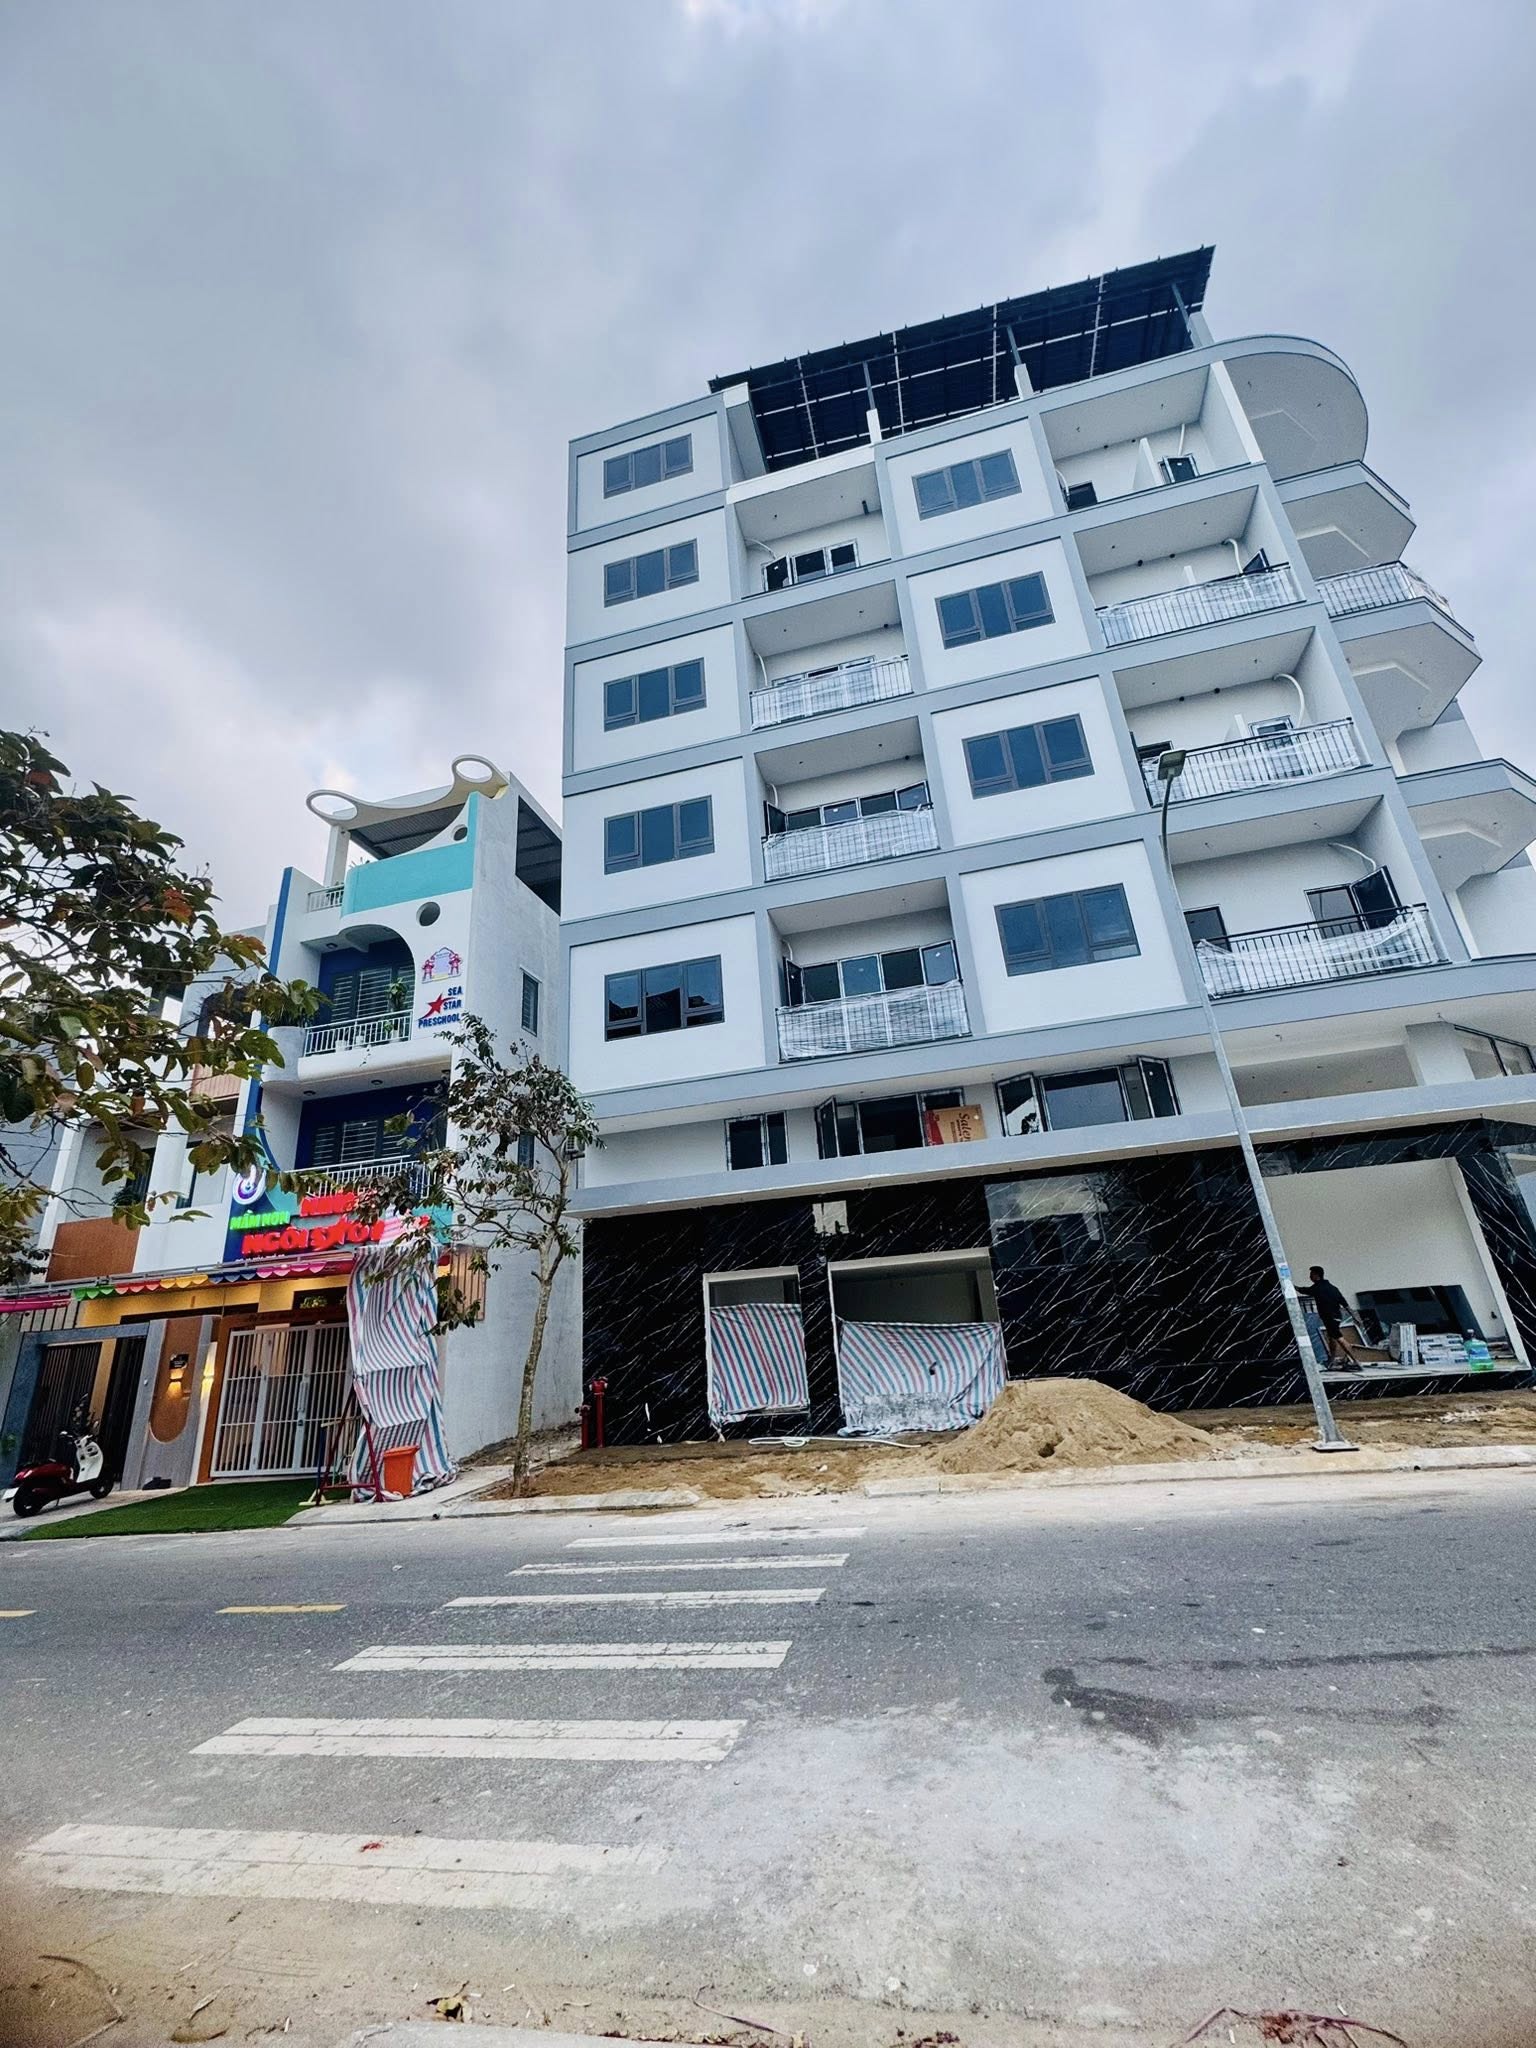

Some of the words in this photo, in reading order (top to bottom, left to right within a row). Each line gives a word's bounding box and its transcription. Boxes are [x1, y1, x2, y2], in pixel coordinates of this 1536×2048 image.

[447, 985, 463, 996] SEA
[443, 999, 462, 1010] STAR
[418, 1013, 461, 1029] PRESCHOOL
[261, 1211, 291, 1227] NON
